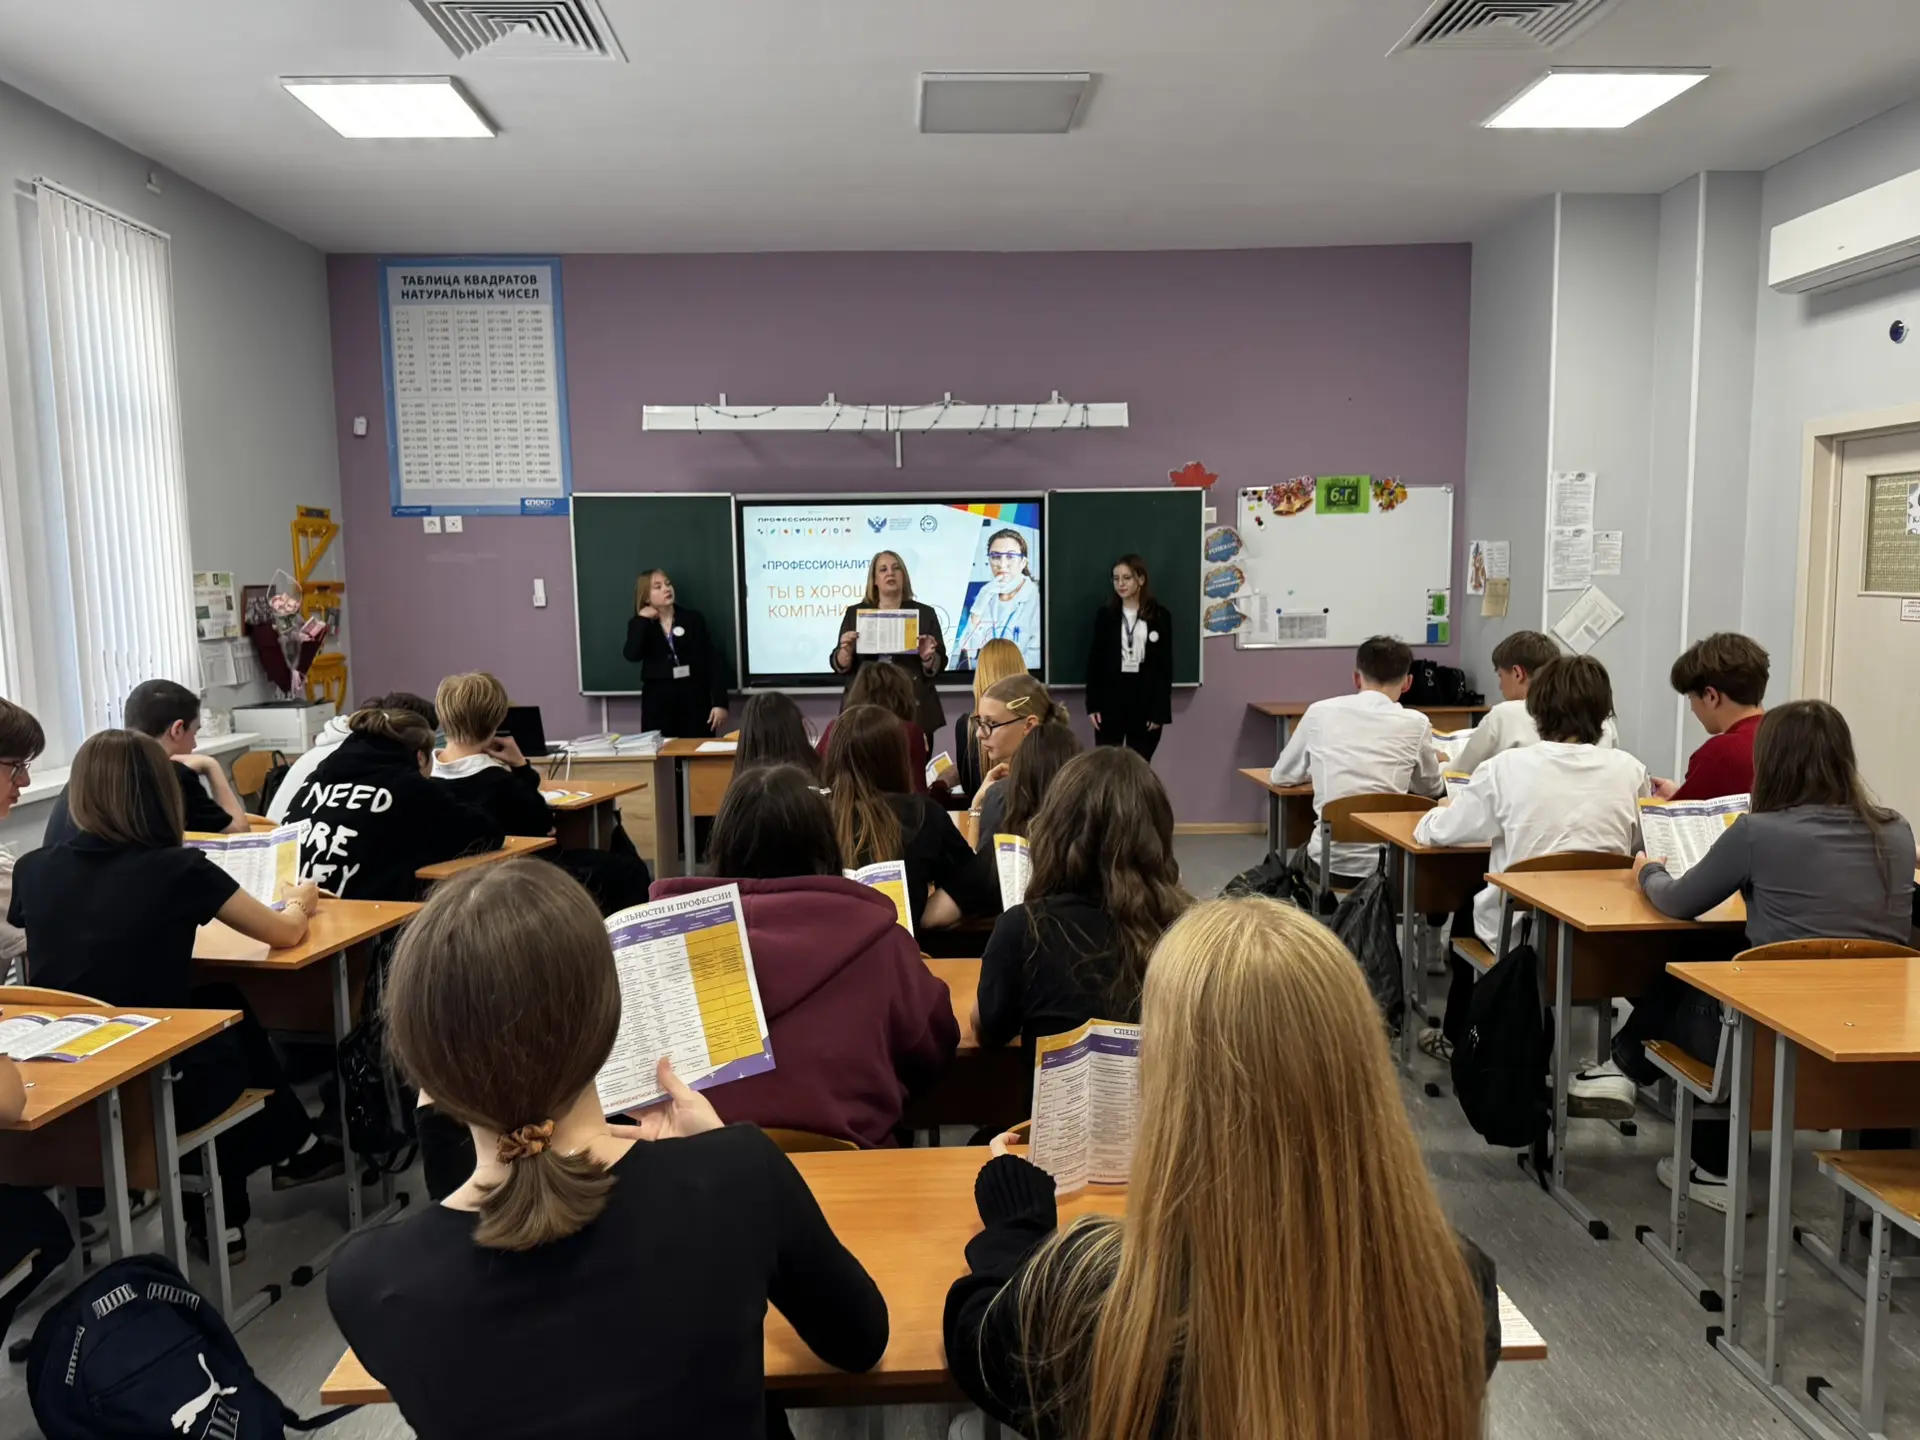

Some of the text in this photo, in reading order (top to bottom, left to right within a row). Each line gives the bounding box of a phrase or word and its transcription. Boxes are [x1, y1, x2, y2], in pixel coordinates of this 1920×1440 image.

[401, 274, 538, 287] ТАБЛИЦА КВАДРАТОВ
[401, 288, 540, 299] НАТУРАЛЬНЫХ ЧИСЕЛ
[762, 560, 872, 570] «ПРОФЕССИОНАЛИТ
[767, 584, 867, 599] ТЫ В ХОРОШ
[768, 604, 849, 618] КОМПАНИ
[302, 781, 393, 814] NEED
[667, 904, 675, 913] И
[676, 891, 732, 911] ПРОФЕССИИ
